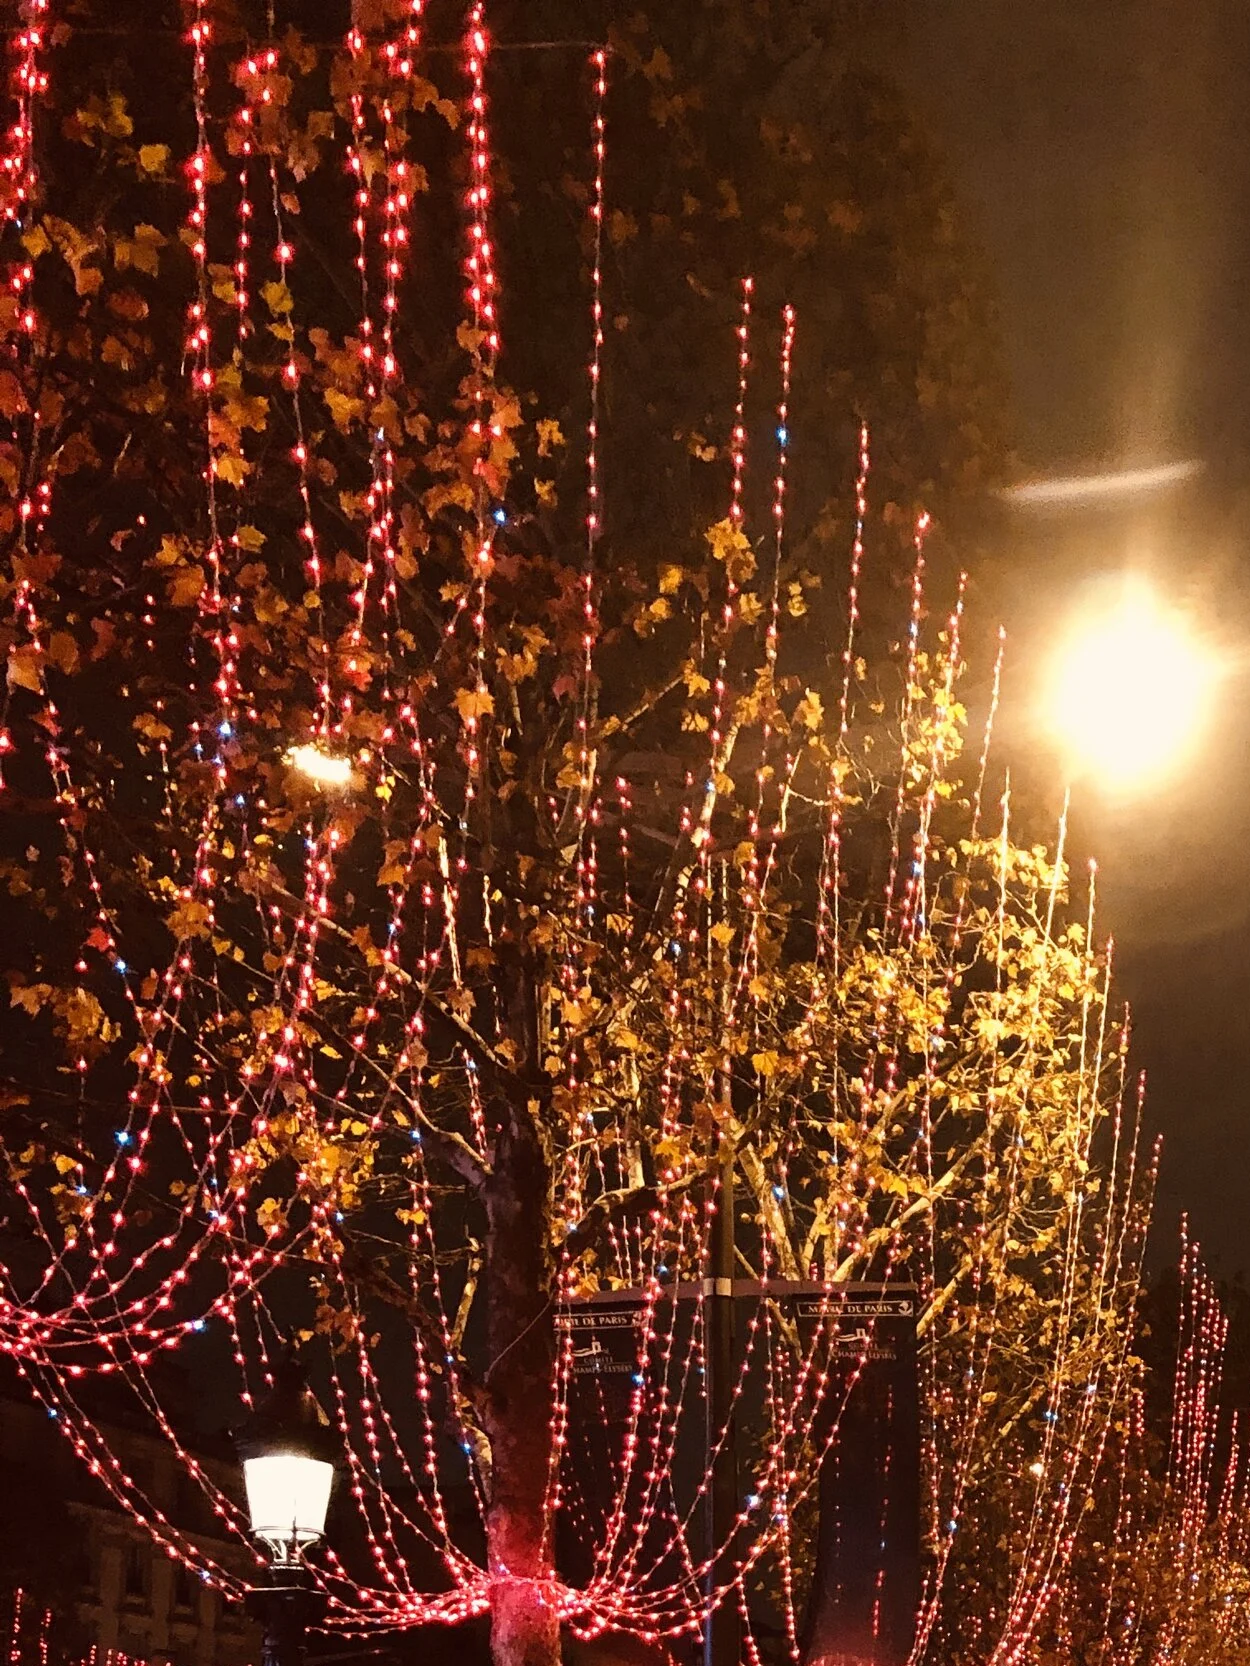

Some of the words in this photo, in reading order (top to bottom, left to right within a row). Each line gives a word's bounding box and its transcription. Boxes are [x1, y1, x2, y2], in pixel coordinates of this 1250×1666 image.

[847, 1305, 861, 1313] DE
[864, 1304, 893, 1313] PARIS
[582, 1317, 596, 1326] DE
[599, 1315, 628, 1325] PARIS
